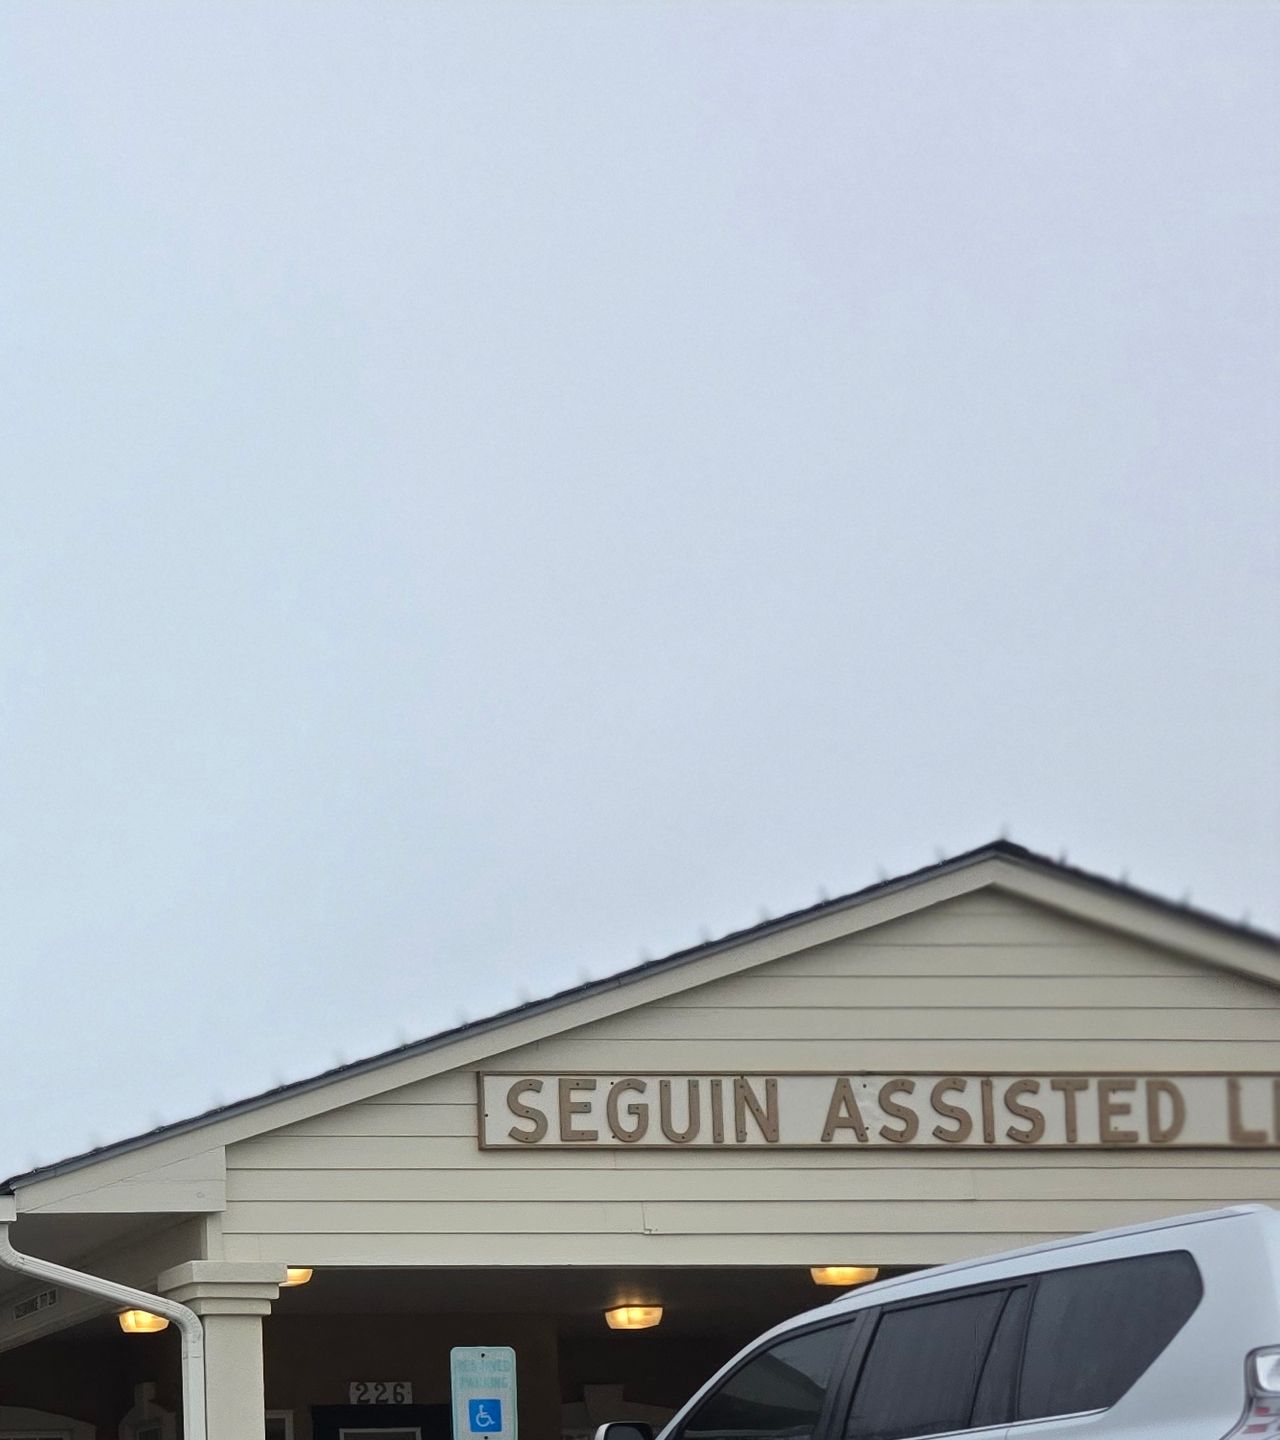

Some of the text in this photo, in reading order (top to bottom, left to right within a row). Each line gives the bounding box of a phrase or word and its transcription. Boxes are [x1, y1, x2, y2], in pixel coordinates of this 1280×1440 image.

[506, 1077, 780, 1143] SEGUIN
[820, 1077, 1186, 1144] ASSISTED
[355, 1382, 405, 1404] 226
